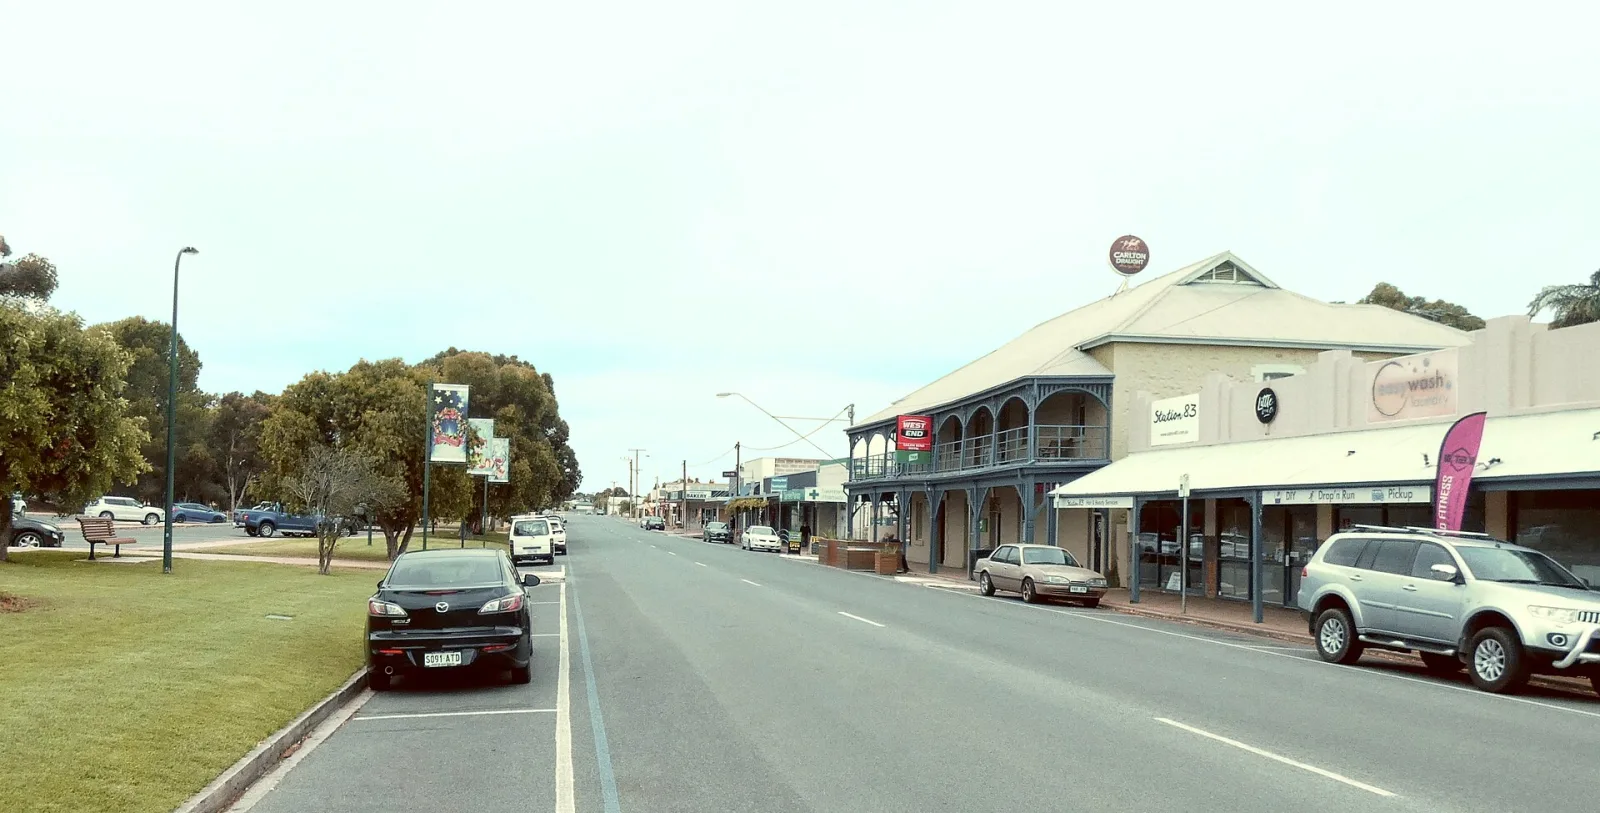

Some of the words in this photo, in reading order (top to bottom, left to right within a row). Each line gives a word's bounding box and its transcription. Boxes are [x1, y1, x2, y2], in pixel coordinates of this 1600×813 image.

[1113, 251, 1147, 260] CARLTON
[1407, 369, 1444, 392] wash
[1153, 409, 1183, 424] Station
[1183, 403, 1197, 418] 83
[903, 421, 927, 429] WEST
[1286, 491, 1296, 500] DIY
[1342, 490, 1355, 500] Run
[1388, 487, 1413, 501] Pickup
[1439, 475, 1453, 519] FITNESS
